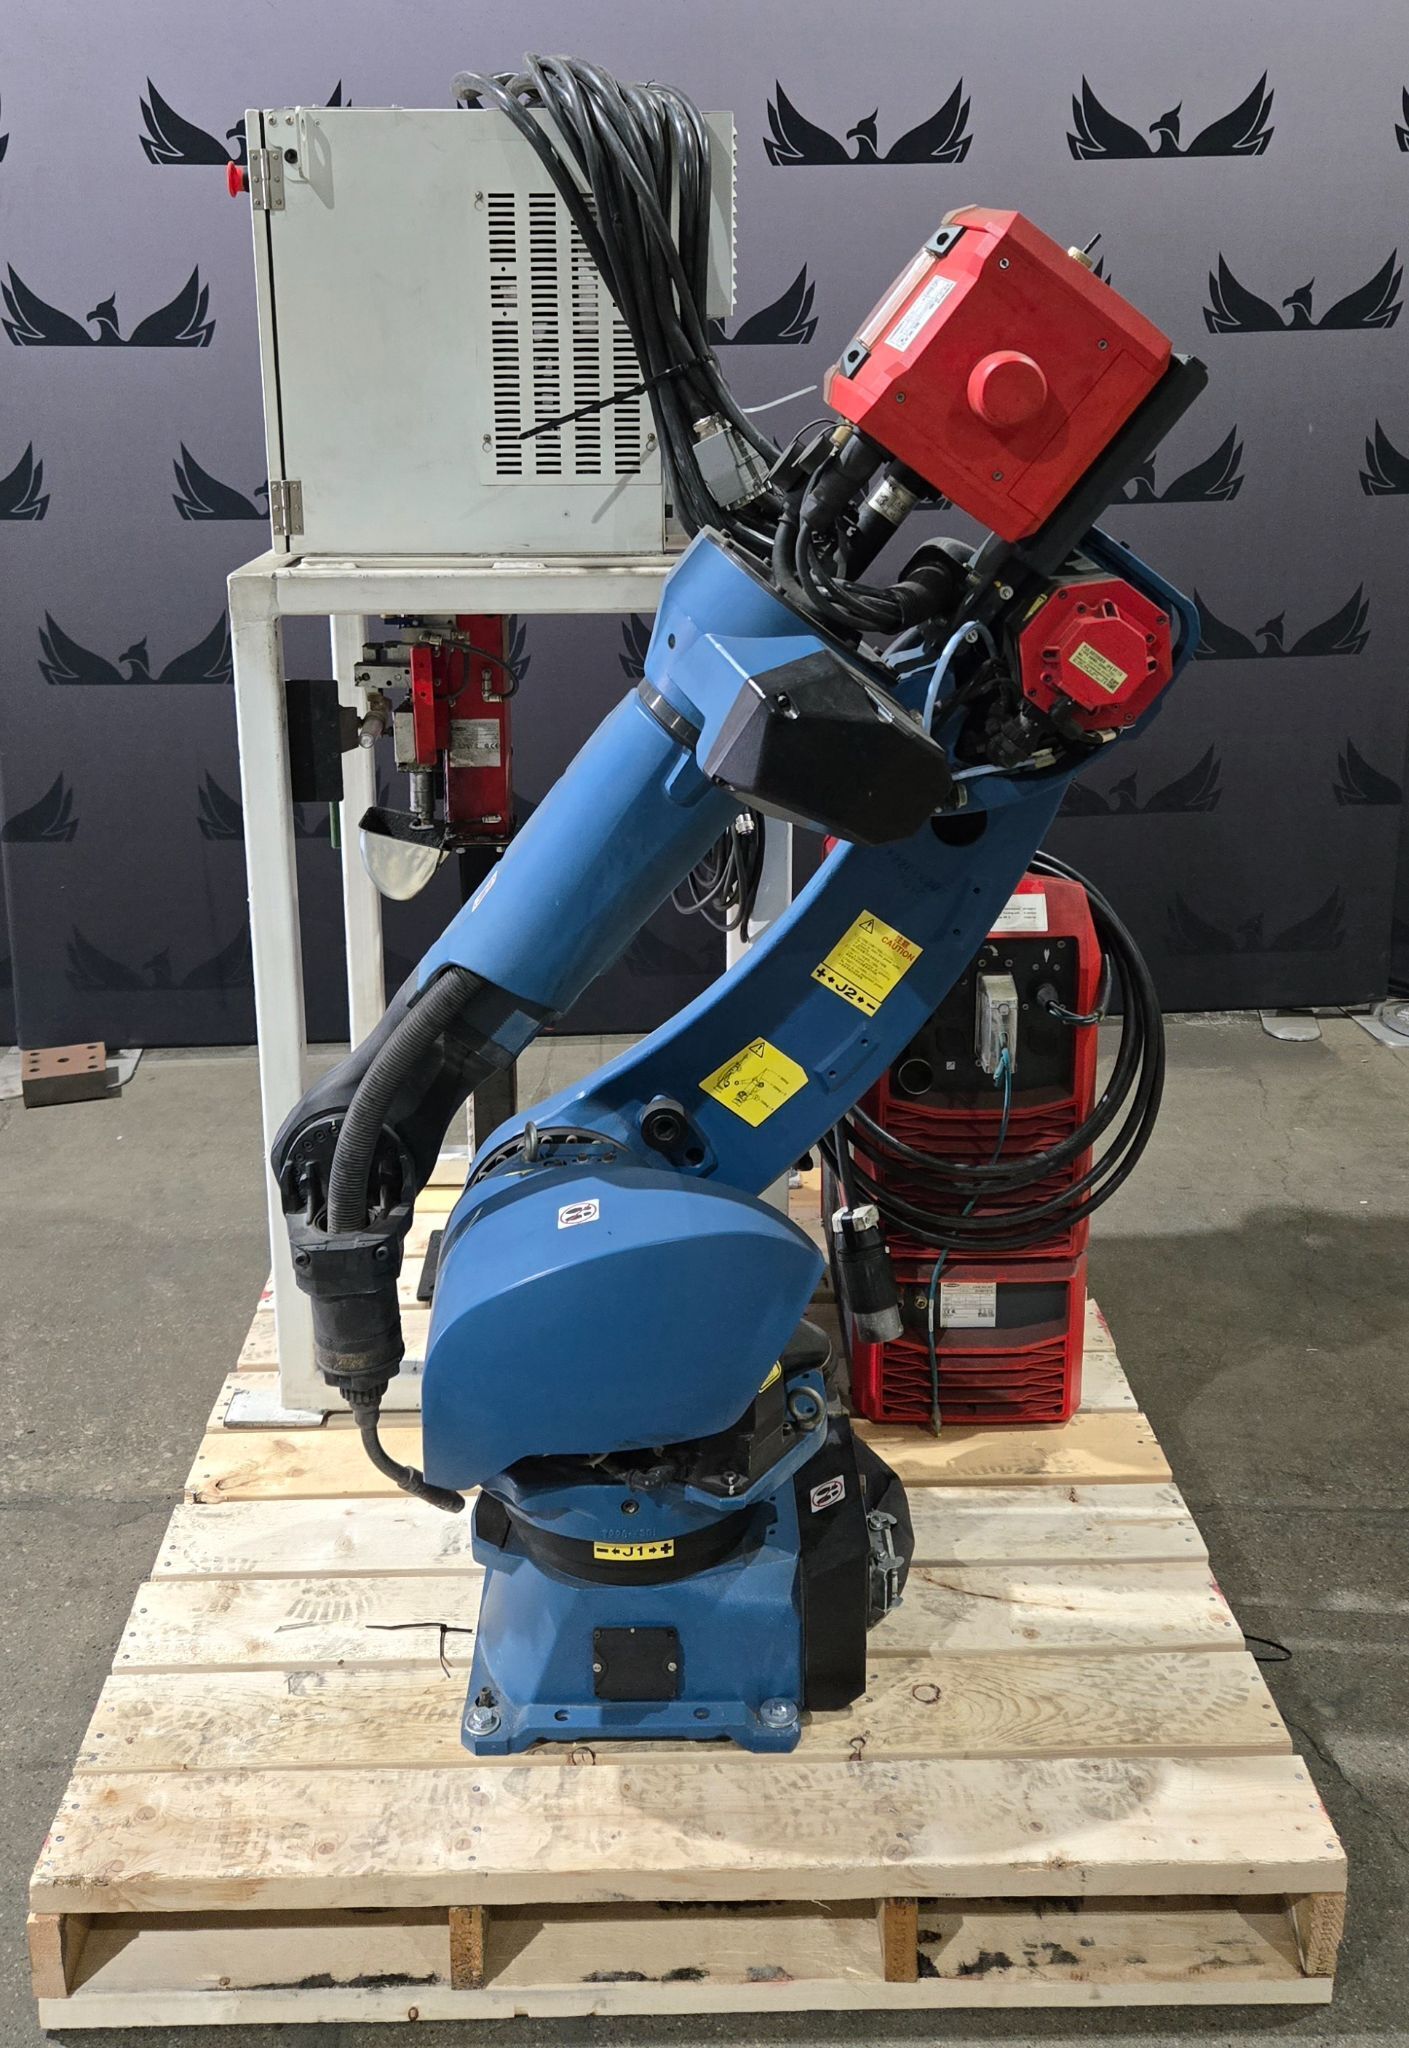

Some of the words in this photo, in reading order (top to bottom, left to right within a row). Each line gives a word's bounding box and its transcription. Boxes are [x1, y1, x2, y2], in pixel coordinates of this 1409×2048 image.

[881, 936, 915, 962] CAUTION
[835, 983, 857, 1000] J2
[622, 1546, 643, 1557] J1
